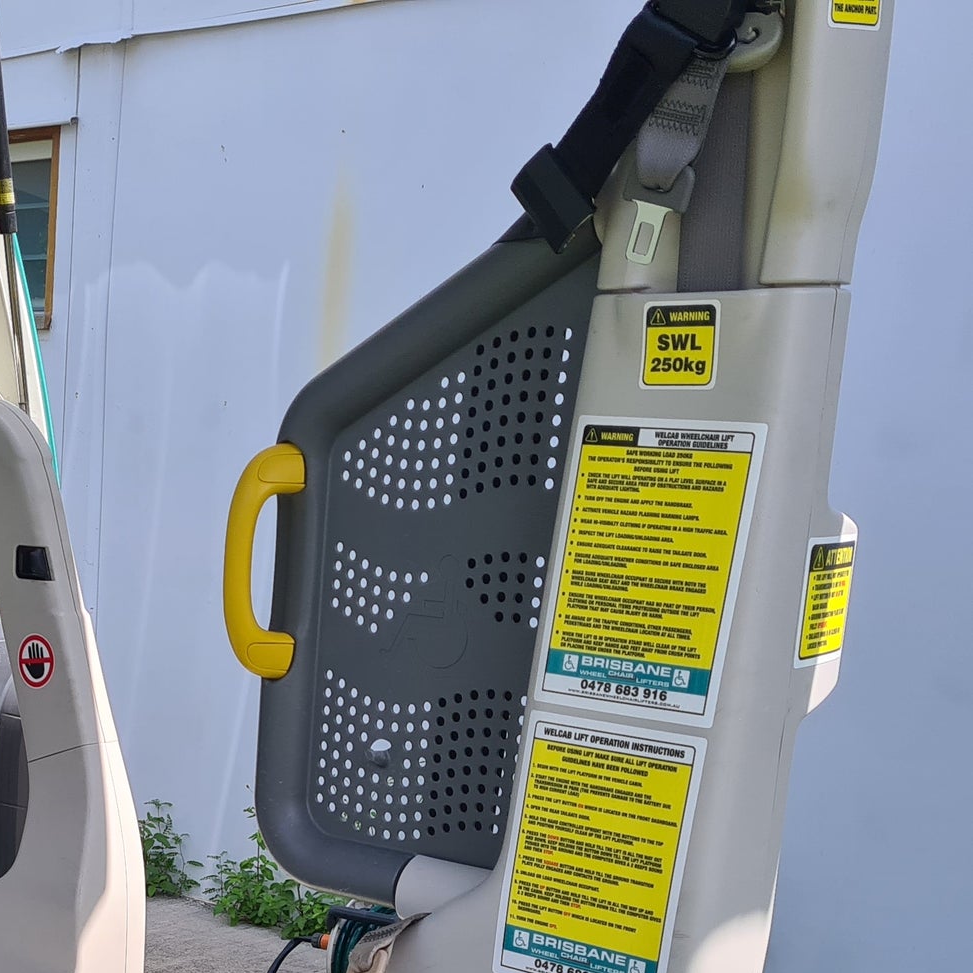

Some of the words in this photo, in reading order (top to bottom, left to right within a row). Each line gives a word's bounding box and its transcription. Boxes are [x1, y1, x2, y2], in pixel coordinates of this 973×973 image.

[834, 3, 843, 12] THE
[845, 4, 864, 13] ANCHOR
[865, 6, 876, 15] PART.
[669, 311, 710, 322] WARNING
[657, 334, 702, 351] SWL
[650, 357, 706, 375] 250kg
[601, 432, 634, 441] WARNING
[654, 431, 679, 439] WELCAB
[680, 432, 720, 441] WHEELCHAIR
[658, 439, 691, 447] OPERATION
[692, 441, 728, 449] GUIDELINES
[581, 655, 671, 677] BRISBANE
[579, 669, 606, 678] WHEEL
[607, 670, 634, 678] CHAIR
[635, 677, 669, 687] LIFTERS
[580, 678, 611, 693] 0478
[615, 684, 639, 697] 683
[642, 688, 667, 701] 916
[544, 727, 572, 739] WELCAB
[573, 732, 589, 742] LIFT
[590, 735, 630, 749] OPERATION
[631, 742, 685, 758] INSTRUCTIONS
[546, 744, 566, 753] BEFORE
[566, 747, 582, 756] USING
[594, 752, 609, 760] MAKE
[610, 755, 624, 763] SURE
[647, 762, 677, 772] OPERATION
[561, 756, 590, 766] GUIDELINES
[620, 766, 648, 777] FOLLOWED
[530, 947, 559, 959] WHEEL
[560, 951, 587, 963] CHAIR
[532, 933, 626, 966] BRISBANE
[534, 958, 563, 973] 0478
